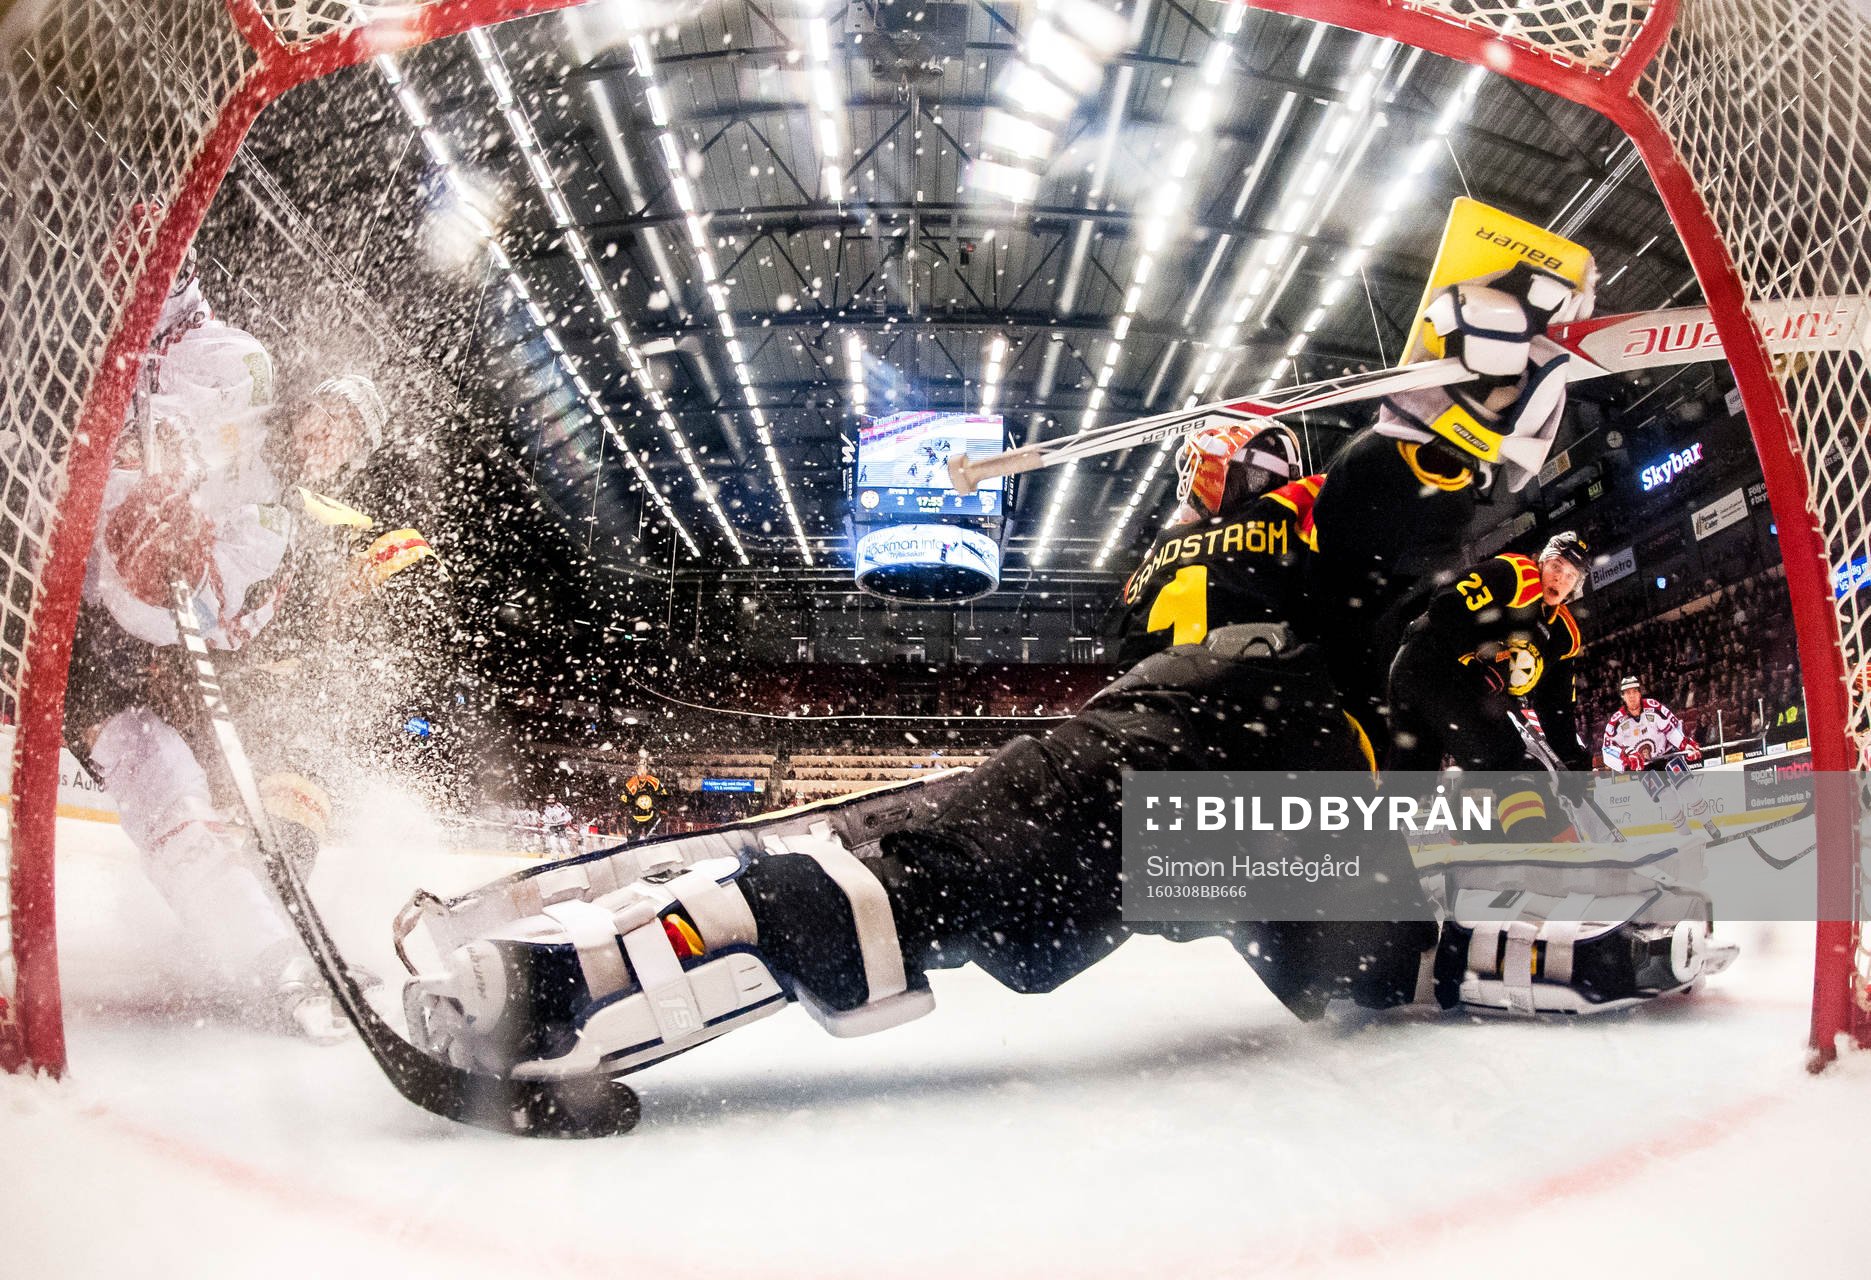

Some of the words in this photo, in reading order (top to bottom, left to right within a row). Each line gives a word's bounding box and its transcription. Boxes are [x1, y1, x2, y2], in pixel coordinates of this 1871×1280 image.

[1475, 226, 1562, 270] BAUER
[1141, 419, 1206, 443] BAUER
[1641, 442, 1703, 491] Skybar
[1126, 520, 1288, 604] SANDSTRÖM
[1593, 558, 1633, 584] Bilmetro
[1147, 565, 1208, 646] 1
[1456, 573, 1493, 611] 23
[1609, 795, 1631, 805] Resor
